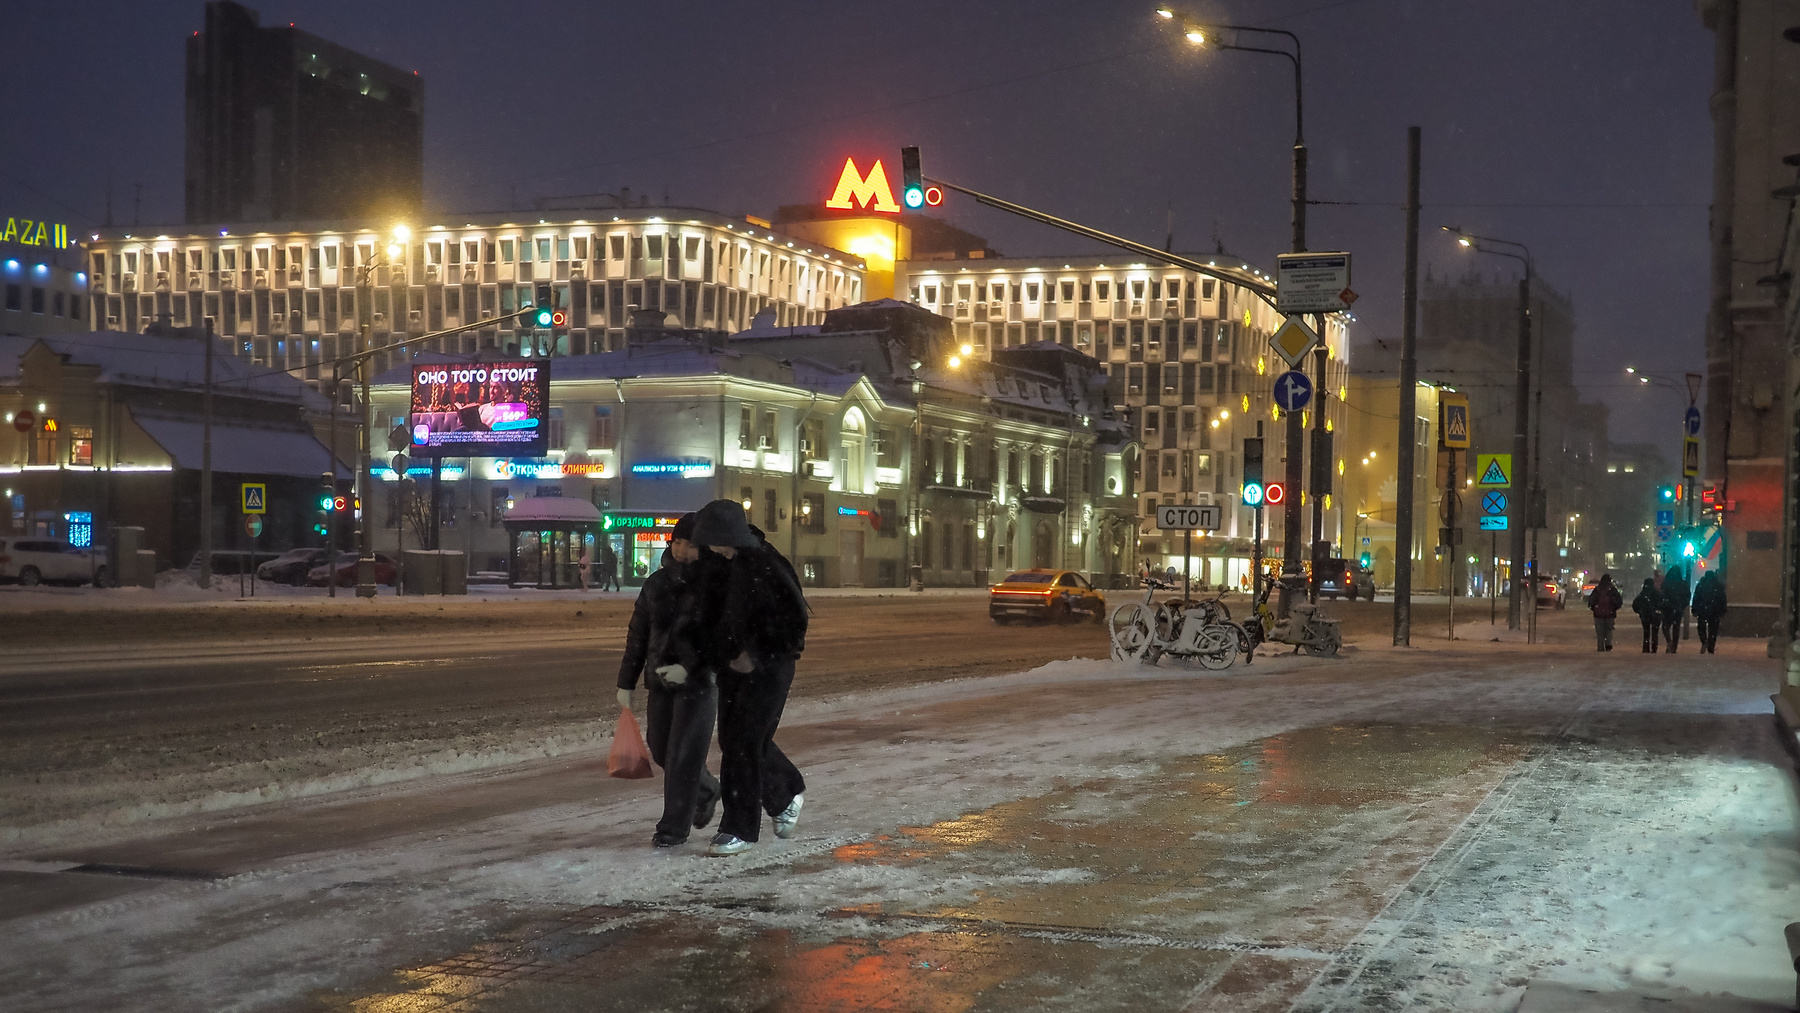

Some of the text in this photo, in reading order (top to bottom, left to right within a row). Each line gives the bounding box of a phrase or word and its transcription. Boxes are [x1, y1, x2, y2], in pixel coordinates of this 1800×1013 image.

[0, 217, 49, 246] AZA
[418, 368, 538, 385] ОНО ТОГО СТОИТ
[561, 464, 604, 475] клиника
[632, 465, 660, 473] АНАЛИЗЫ
[612, 517, 654, 528] ГОРЗДРАВ
[1165, 509, 1211, 526] СТОП
[636, 533, 661, 541] АВИА
